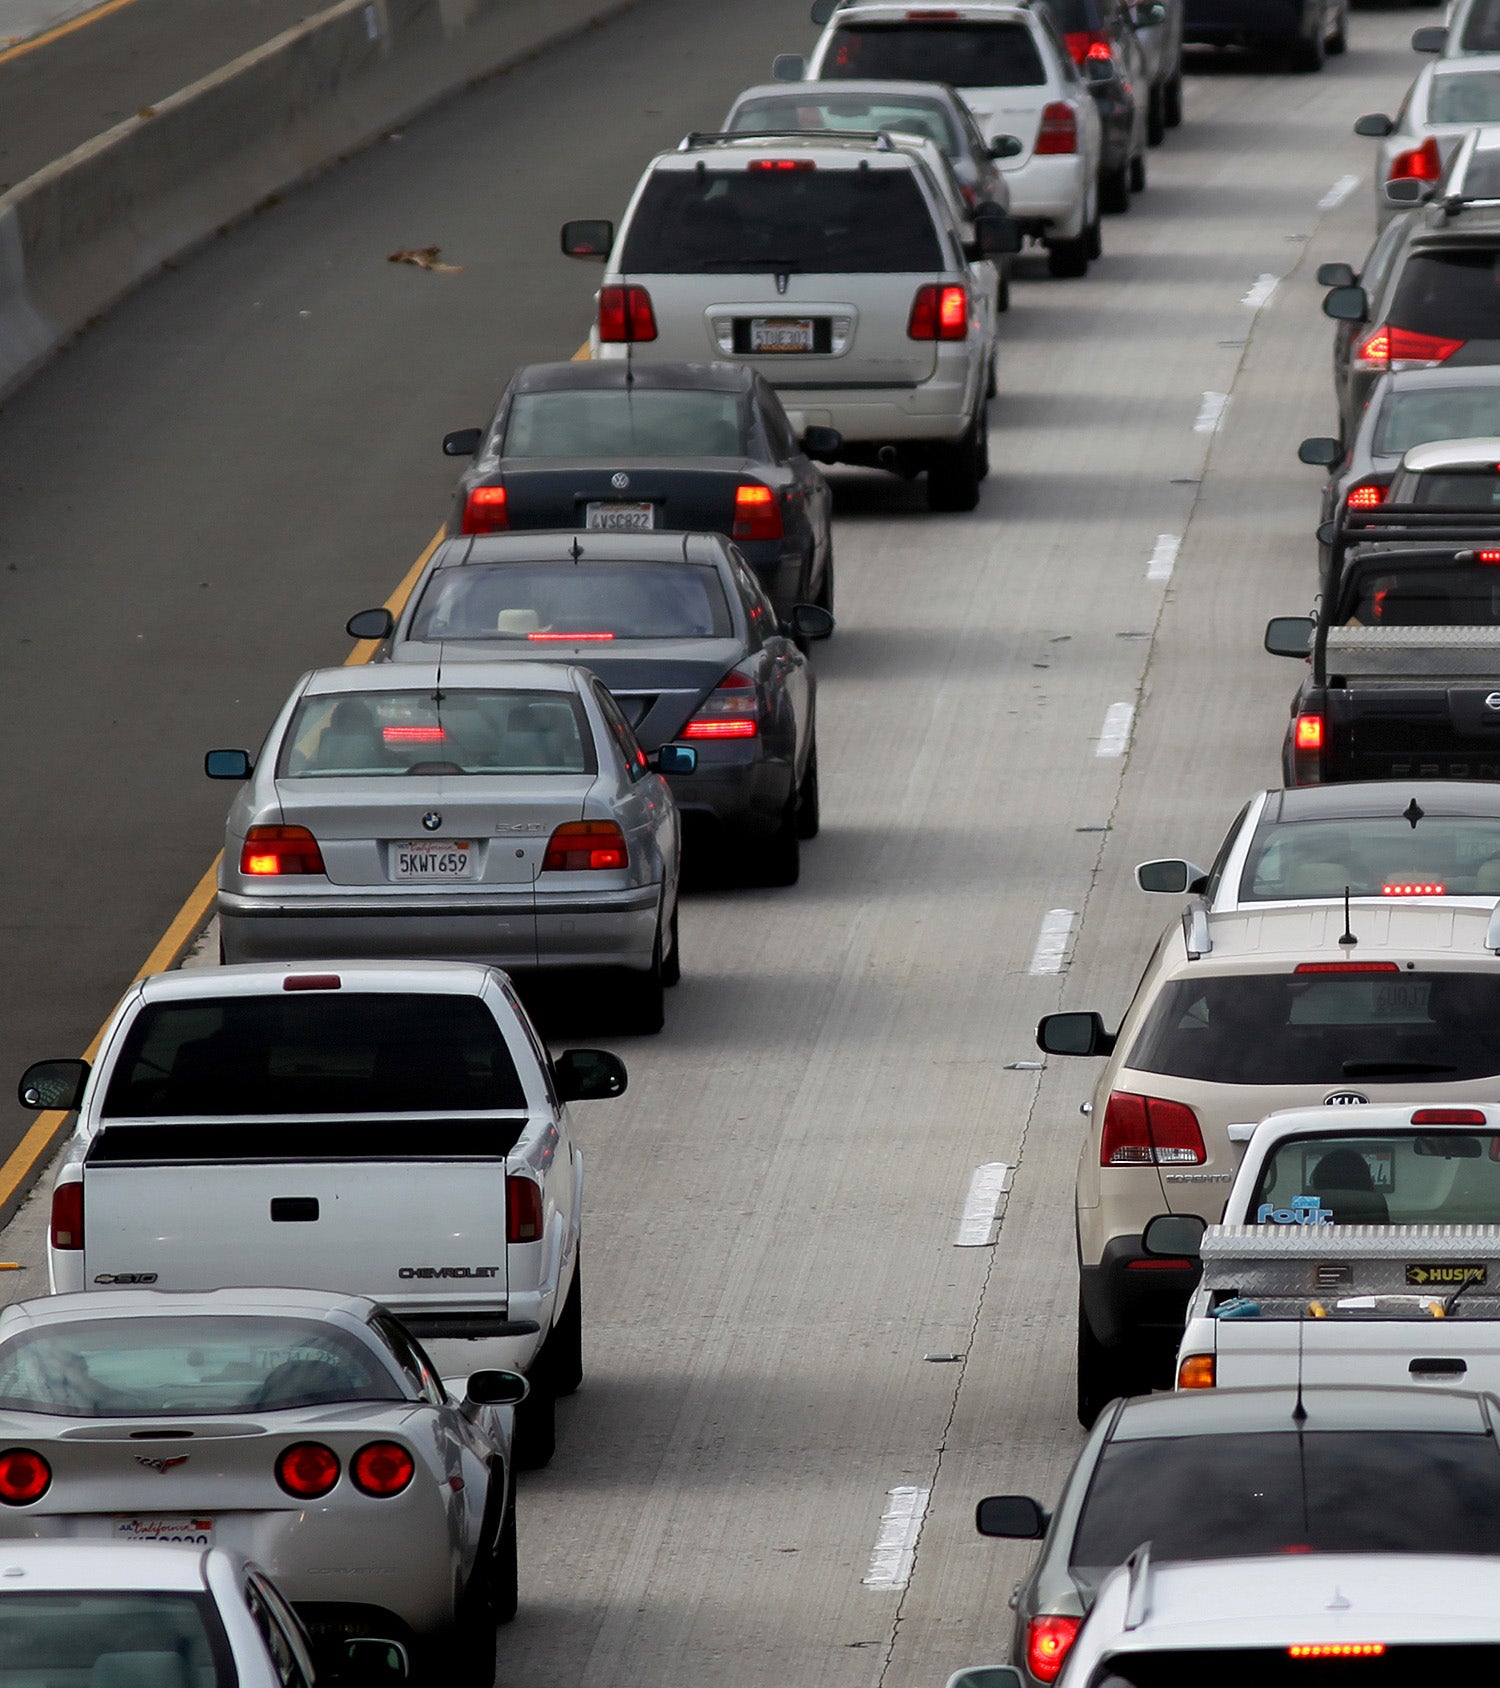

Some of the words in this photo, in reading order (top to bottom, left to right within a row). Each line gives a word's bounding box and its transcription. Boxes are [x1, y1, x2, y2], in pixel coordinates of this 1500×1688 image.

[400, 853, 468, 873] 5KWT659
[1332, 1097, 1361, 1105] KIA
[1166, 1174, 1232, 1184] SORENTO
[1257, 1203, 1334, 1225] four
[115, 1273, 158, 1284] S10
[398, 1267, 500, 1279] CHEVROLET
[133, 1521, 191, 1536] California
